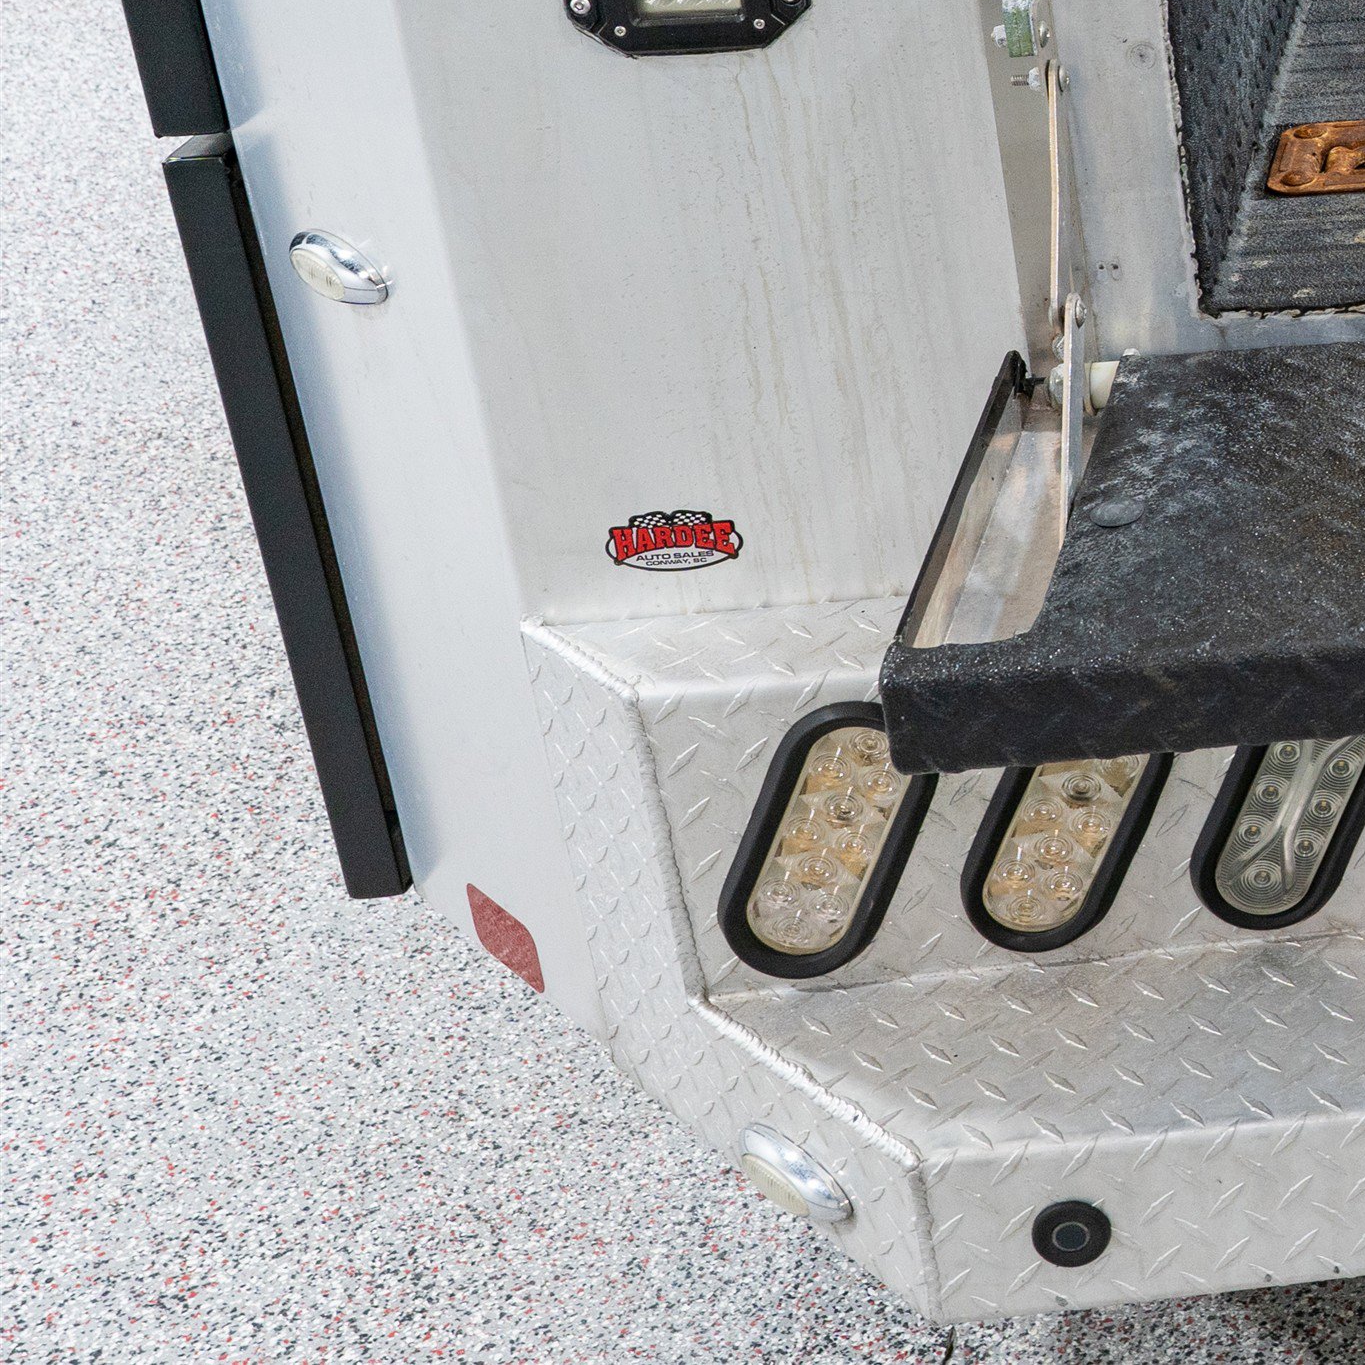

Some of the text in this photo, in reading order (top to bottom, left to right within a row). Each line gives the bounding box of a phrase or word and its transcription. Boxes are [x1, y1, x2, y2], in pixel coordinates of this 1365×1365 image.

[612, 522, 735, 561] HARDEE
[636, 550, 714, 561] AUTO SALES
